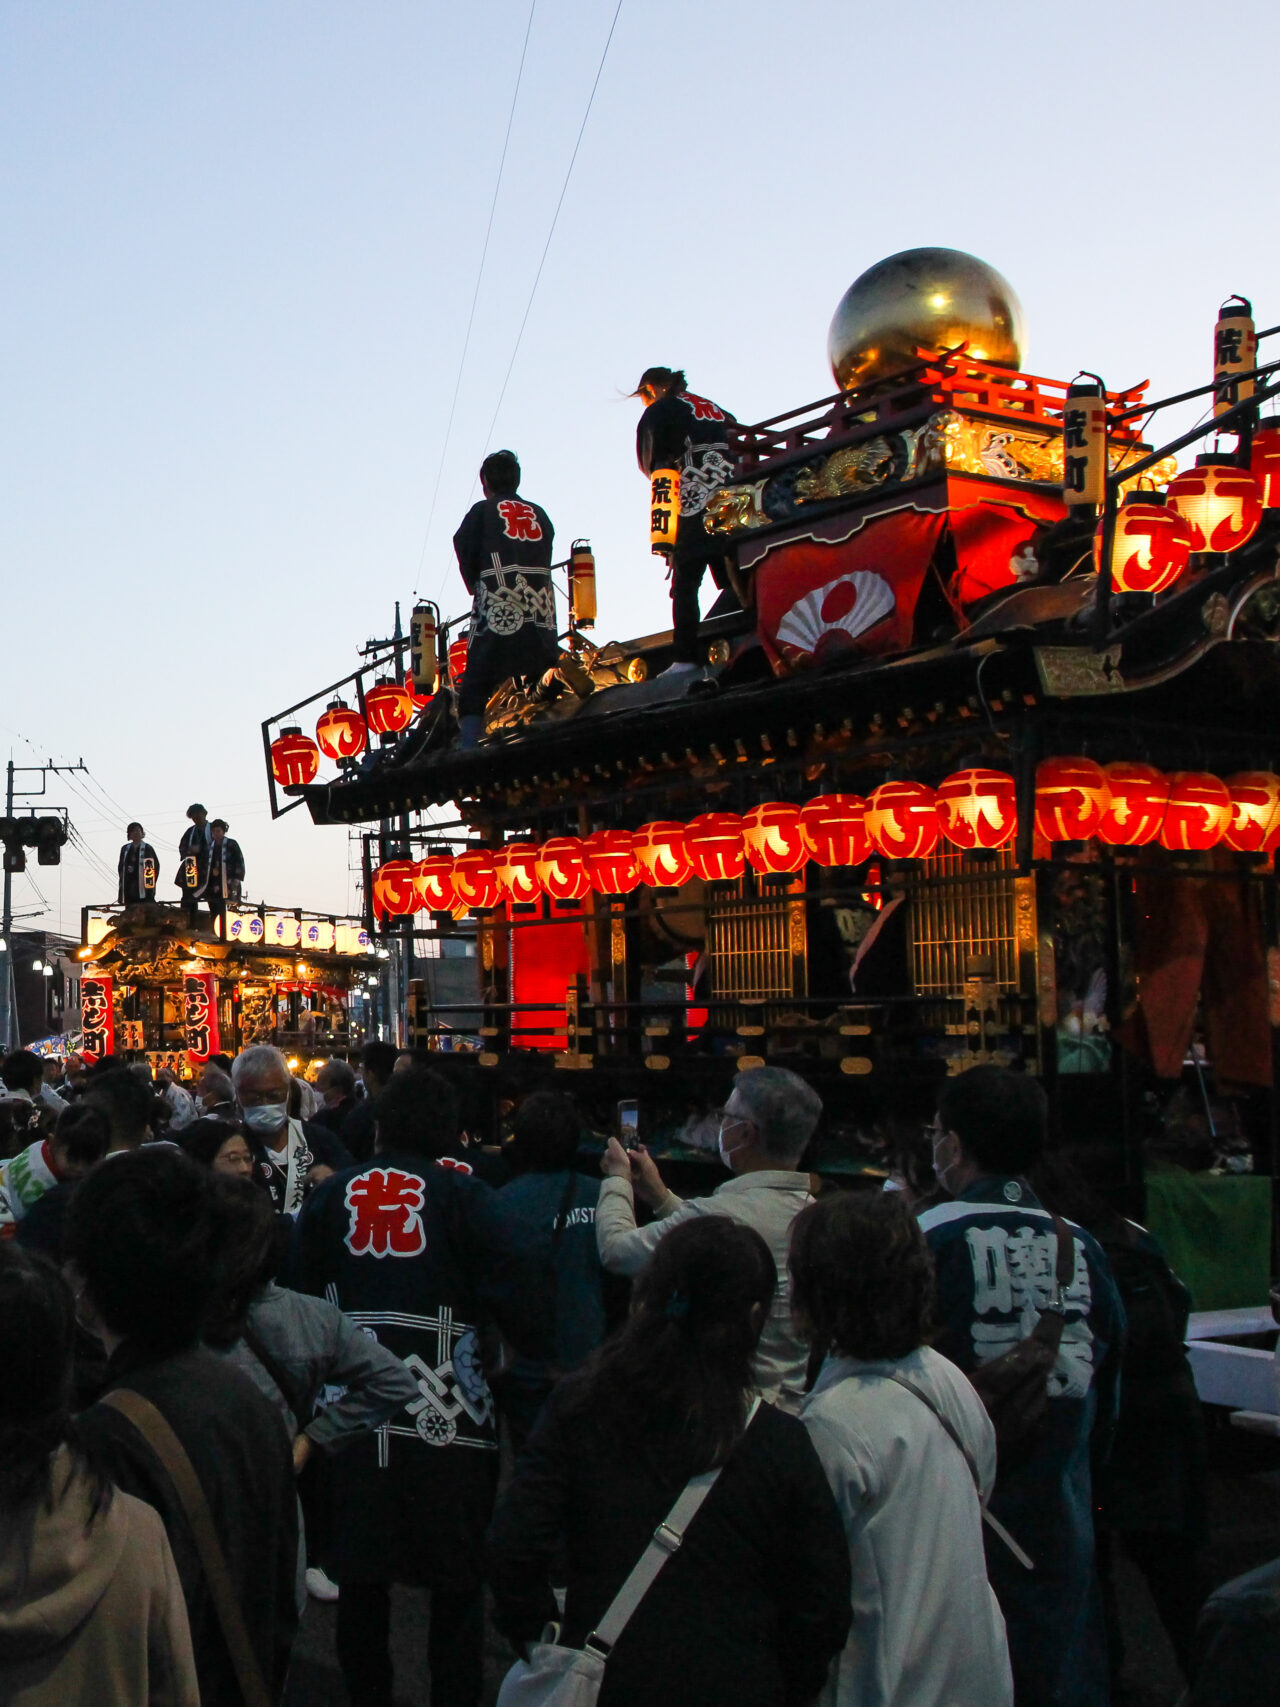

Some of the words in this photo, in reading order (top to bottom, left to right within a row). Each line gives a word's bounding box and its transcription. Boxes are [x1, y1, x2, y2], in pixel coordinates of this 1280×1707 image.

[497, 500, 542, 541] 荒
[651, 477, 672, 535] 荒町
[345, 1168, 426, 1258] 荒
